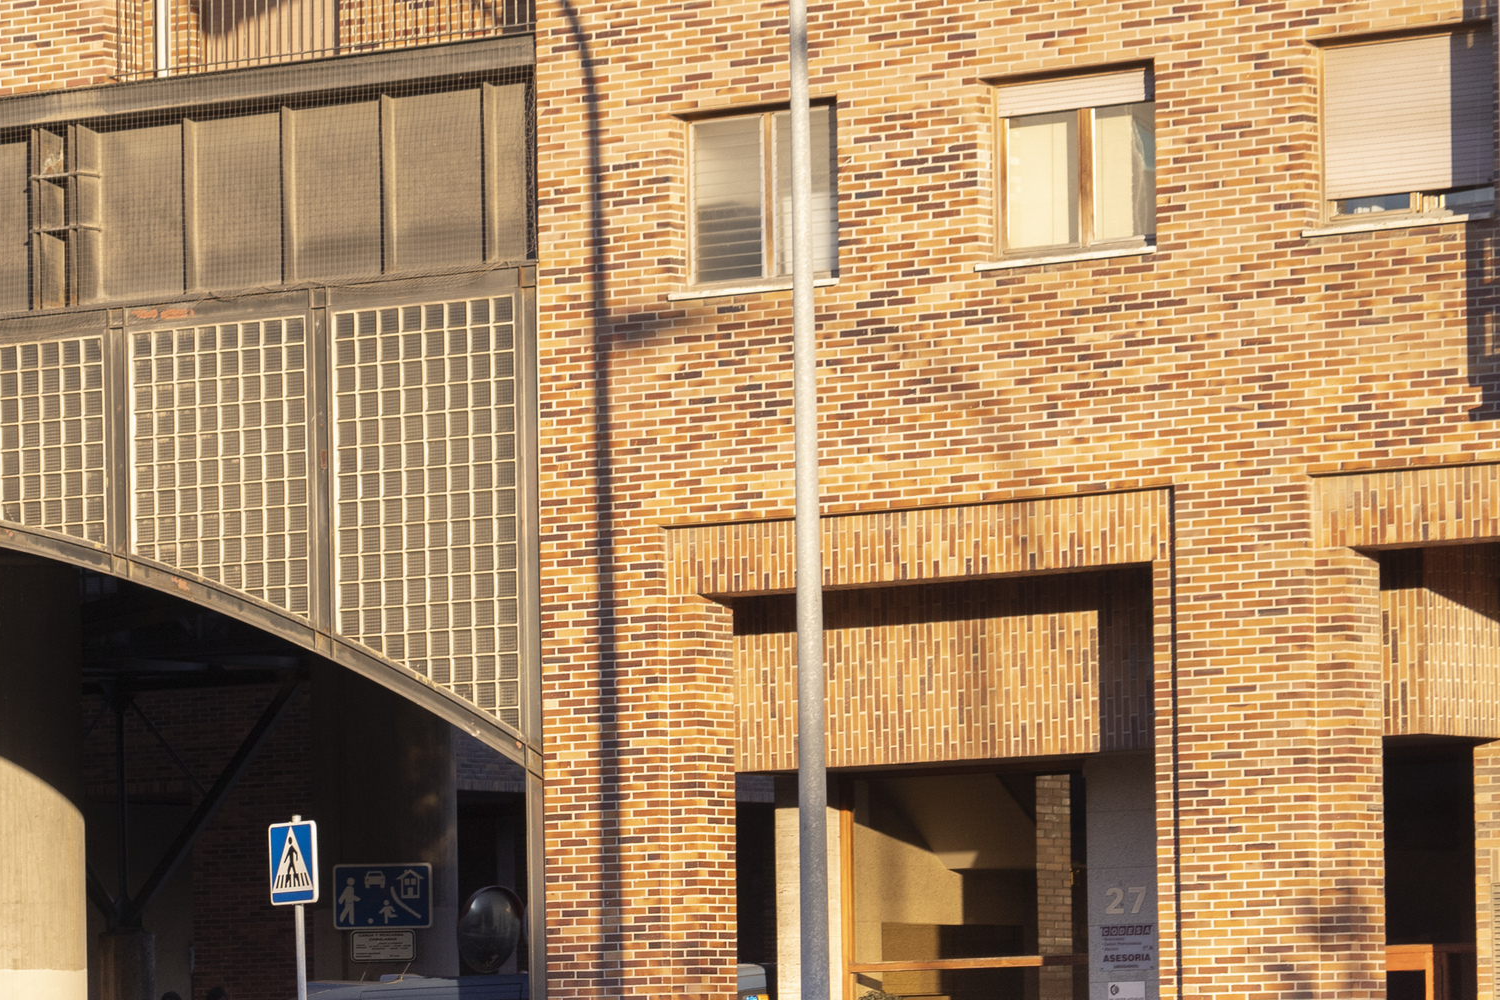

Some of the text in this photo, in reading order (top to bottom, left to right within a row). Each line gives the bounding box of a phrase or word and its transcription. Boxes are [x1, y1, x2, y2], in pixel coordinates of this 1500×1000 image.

[1105, 886, 1147, 915] 27
[1103, 926, 1150, 936] CODESA
[1103, 954, 1151, 963] ASESORIA
